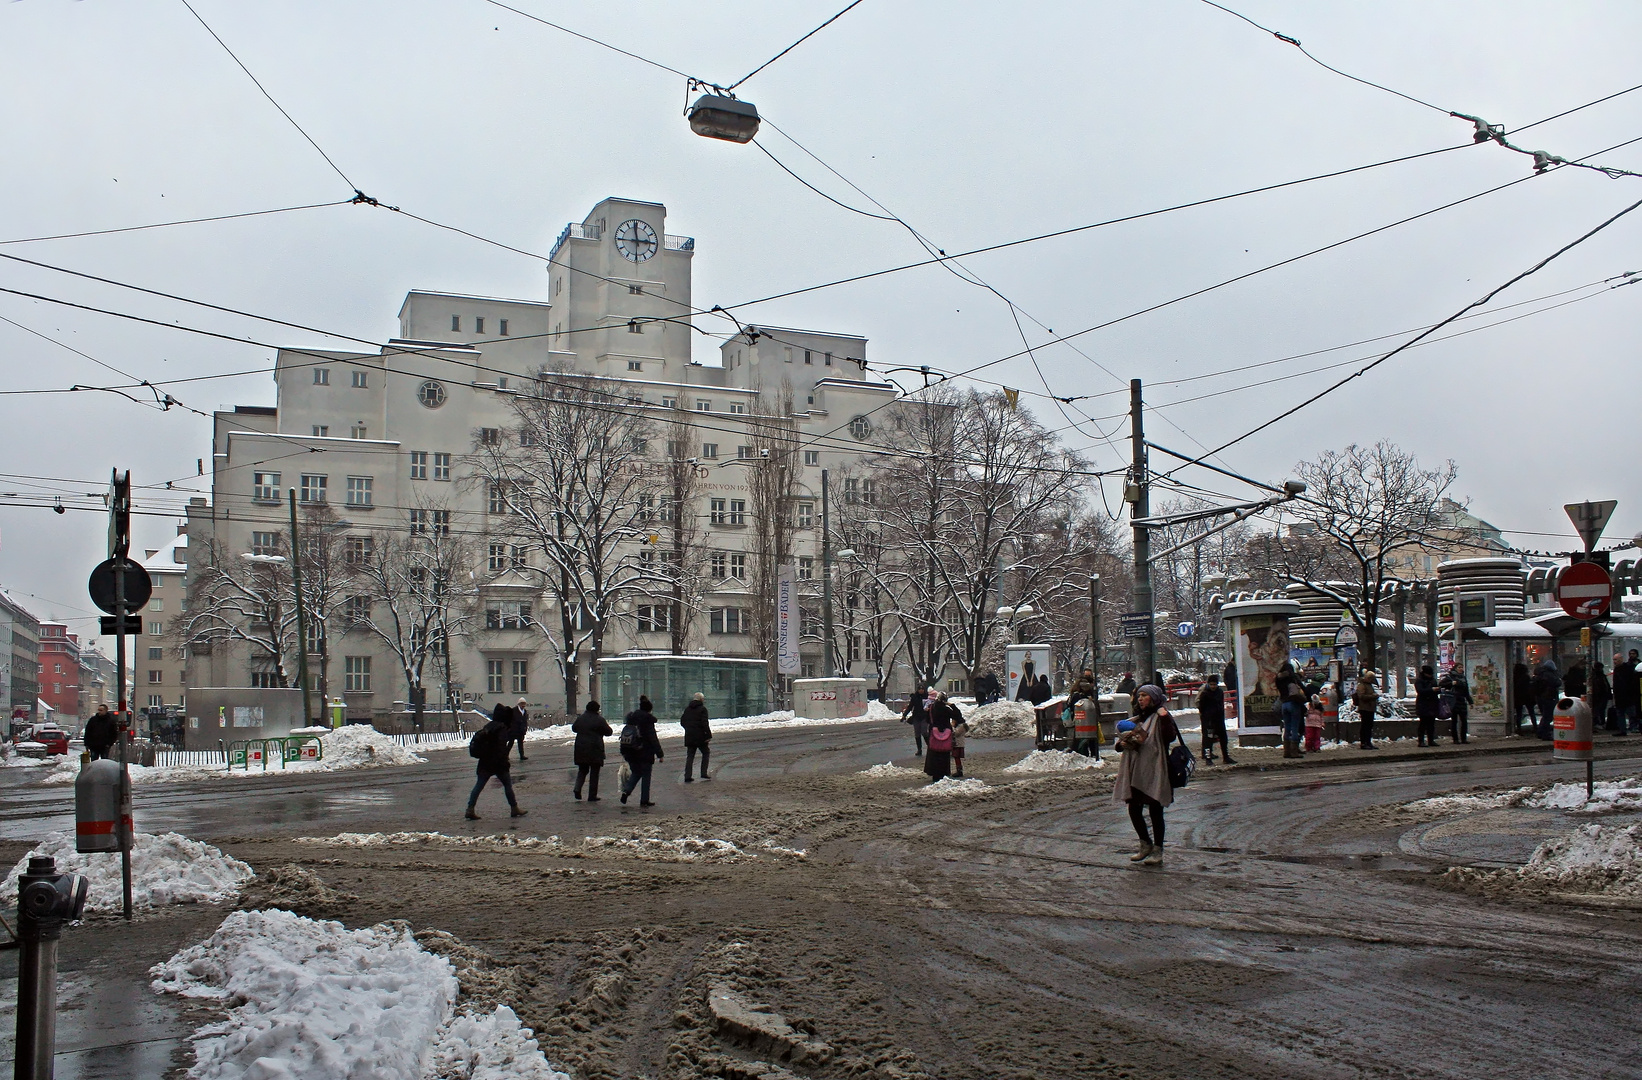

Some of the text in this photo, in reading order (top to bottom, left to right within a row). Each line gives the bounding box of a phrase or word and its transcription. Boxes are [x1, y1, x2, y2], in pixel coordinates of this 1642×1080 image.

[1180, 625, 1189, 636] U
[779, 620, 788, 657] UNSERE
[235, 752, 244, 763] P
[289, 748, 298, 760] P
